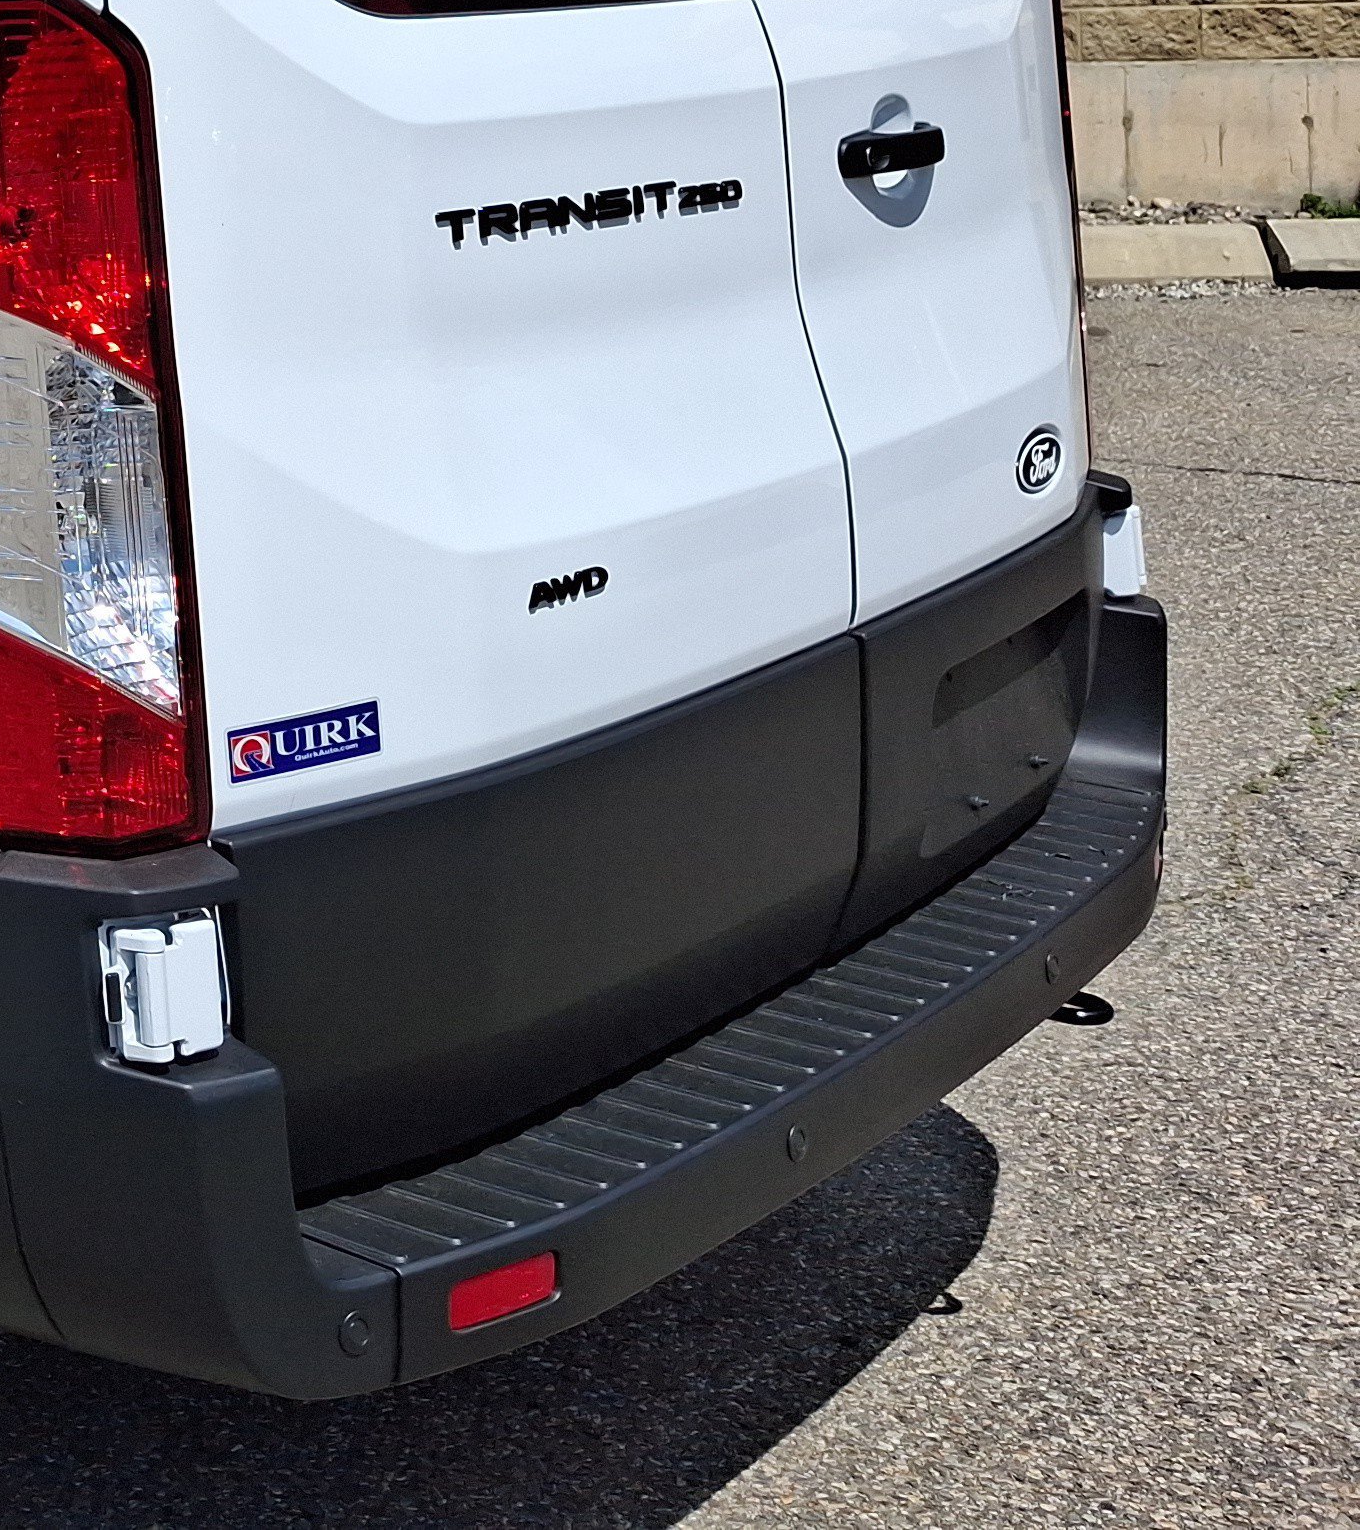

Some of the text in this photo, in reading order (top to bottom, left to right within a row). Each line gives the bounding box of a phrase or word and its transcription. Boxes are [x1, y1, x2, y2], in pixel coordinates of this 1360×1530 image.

[434, 179, 743, 244] TRANSIT 250
[1029, 441, 1057, 484] Ford
[528, 566, 609, 611] AWD
[232, 711, 377, 773] QUIRK
[294, 742, 359, 762] QuirkAuto.com
